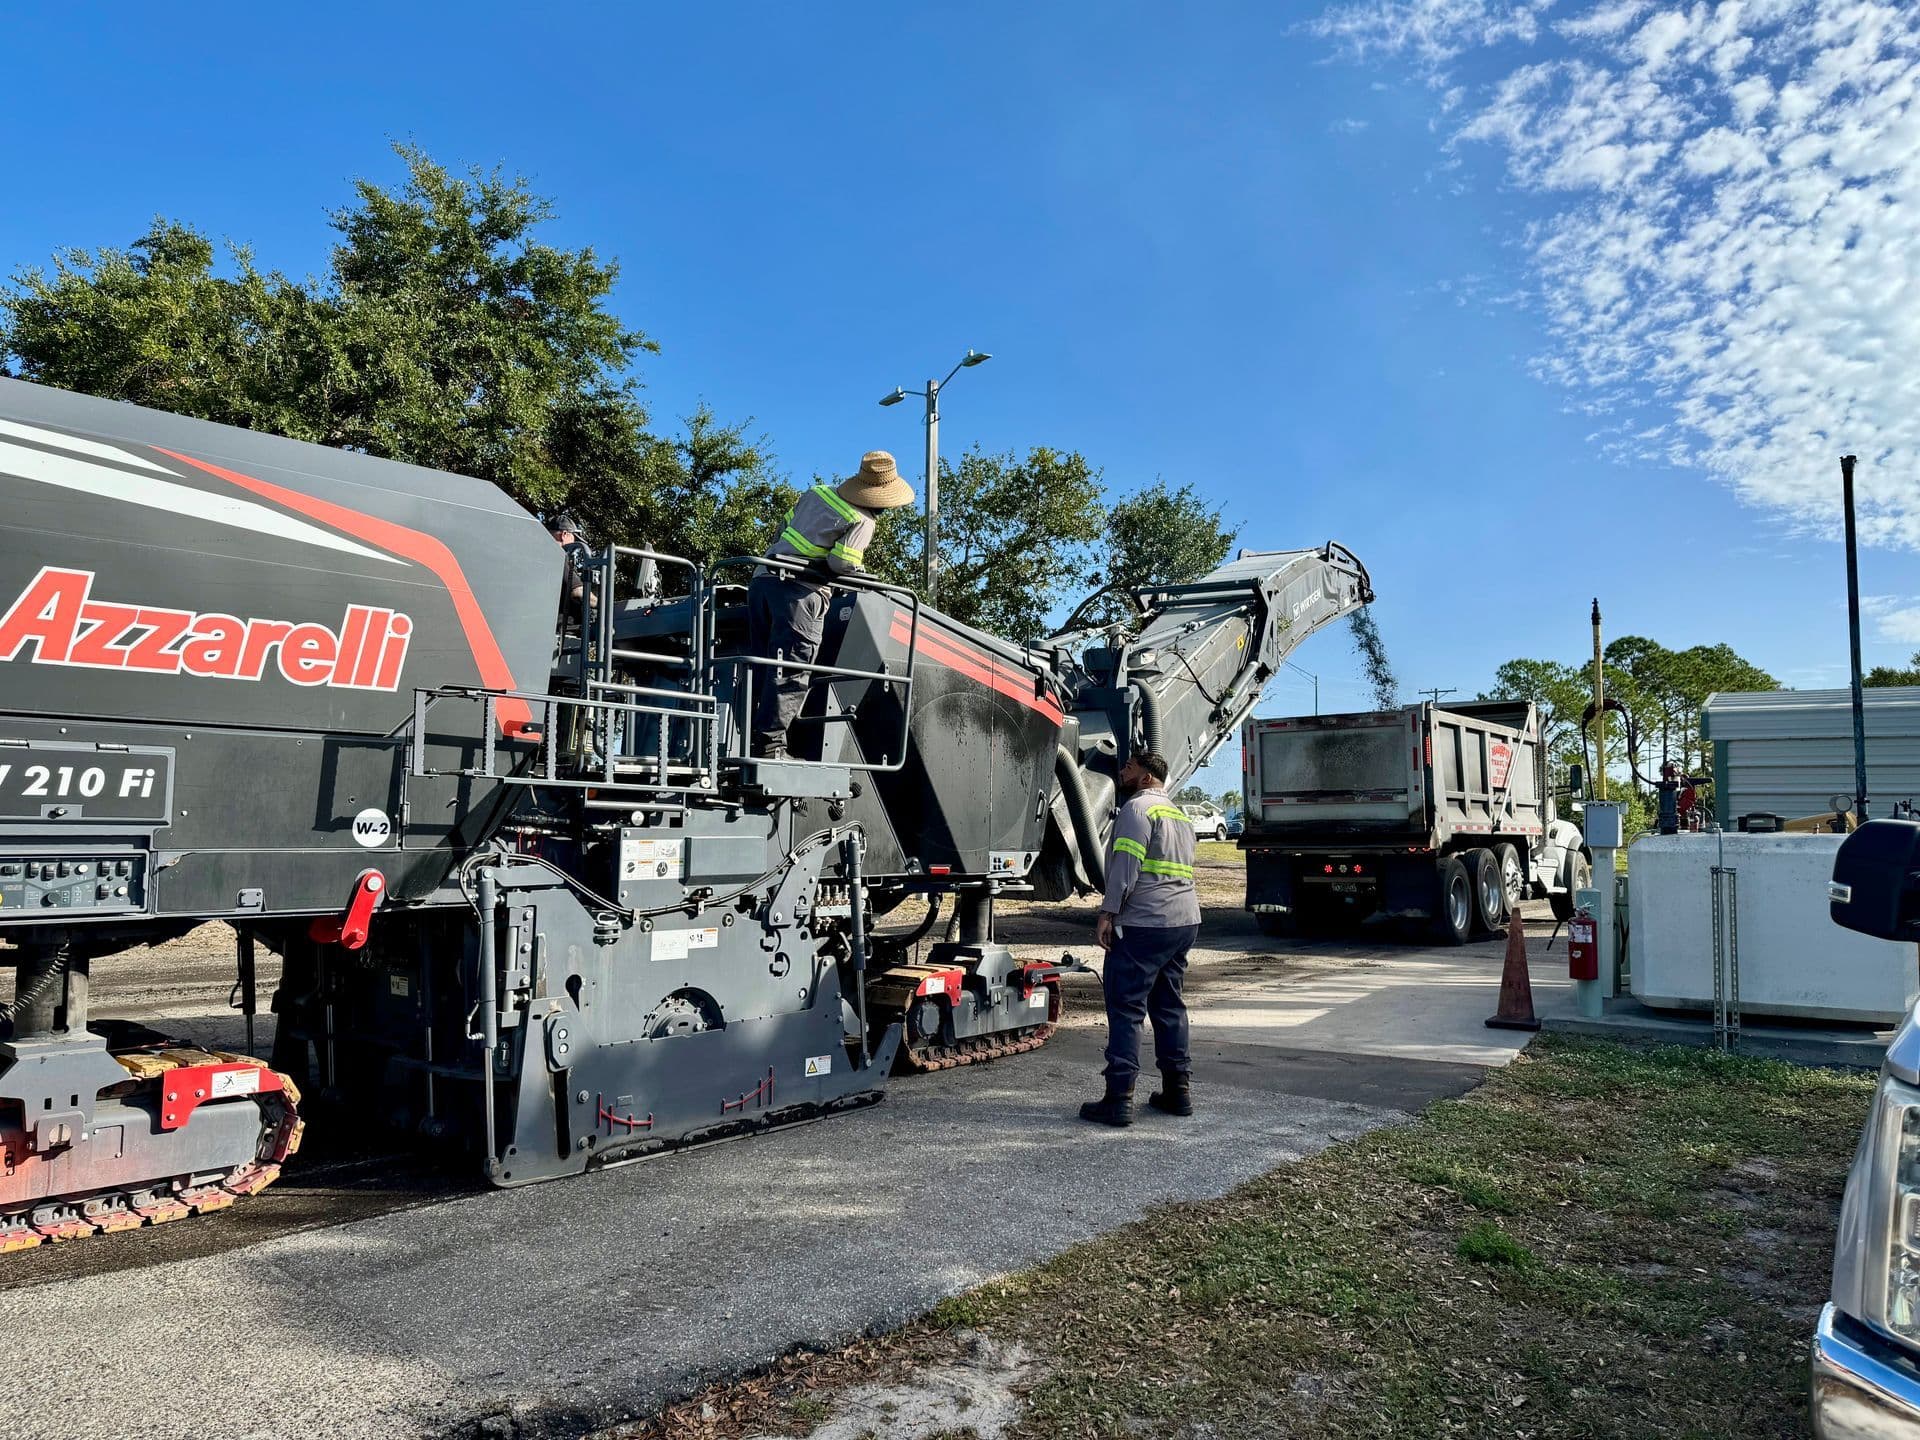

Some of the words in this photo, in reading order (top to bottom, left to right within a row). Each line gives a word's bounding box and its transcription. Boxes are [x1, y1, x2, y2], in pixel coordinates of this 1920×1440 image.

[0, 566, 413, 692] Azzarelli
[21, 765, 106, 797] 210
[118, 768, 156, 798] Fi
[356, 822, 389, 835] W-2
